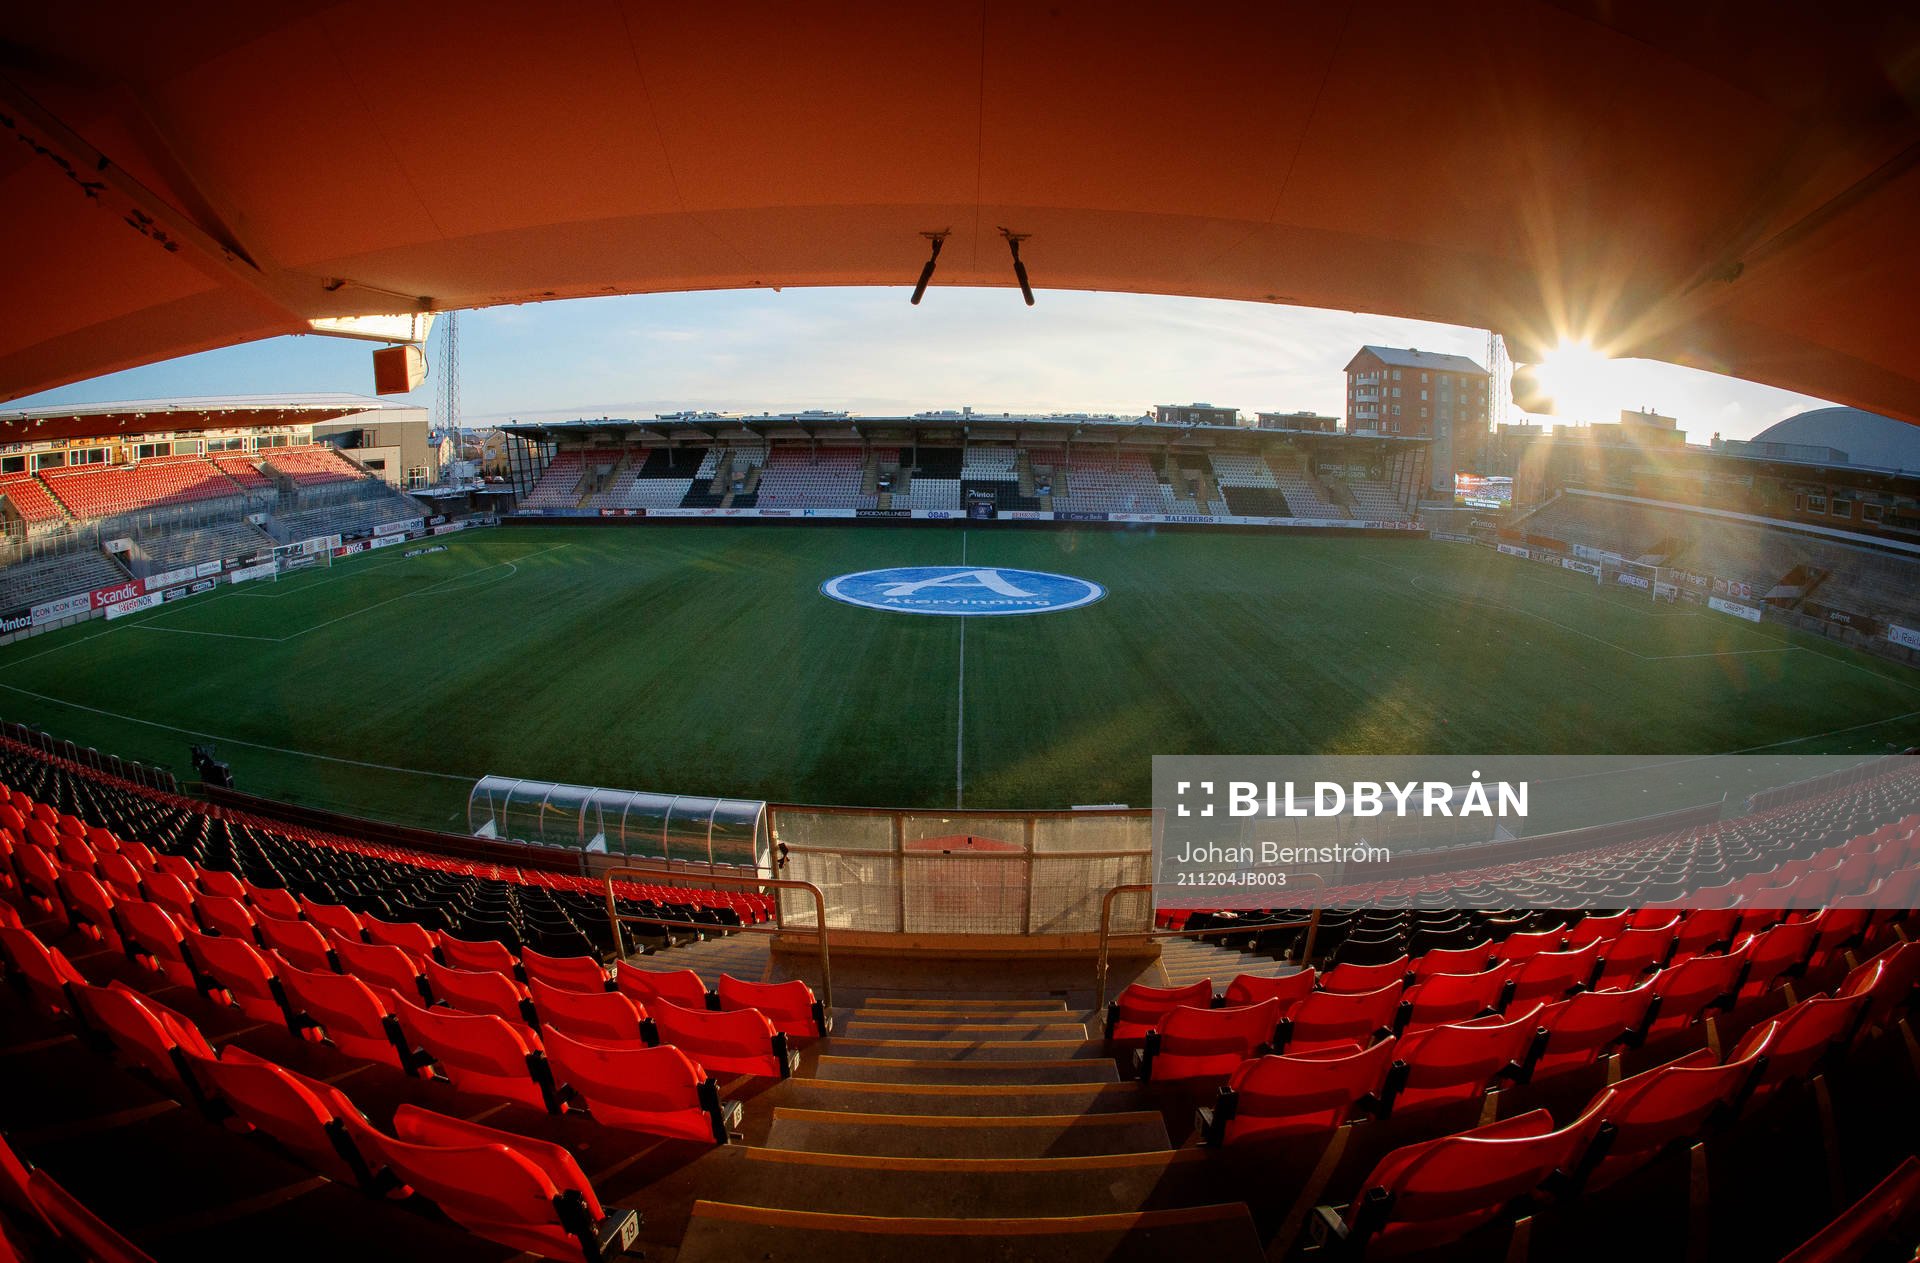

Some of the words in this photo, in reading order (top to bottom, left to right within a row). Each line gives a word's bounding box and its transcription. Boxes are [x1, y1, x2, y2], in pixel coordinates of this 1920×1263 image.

[968, 489, 994, 498] Printoz
[1164, 515, 1214, 523] MALMBERGS
[96, 584, 138, 606] Scandic
[625, 1222, 635, 1240] 19
